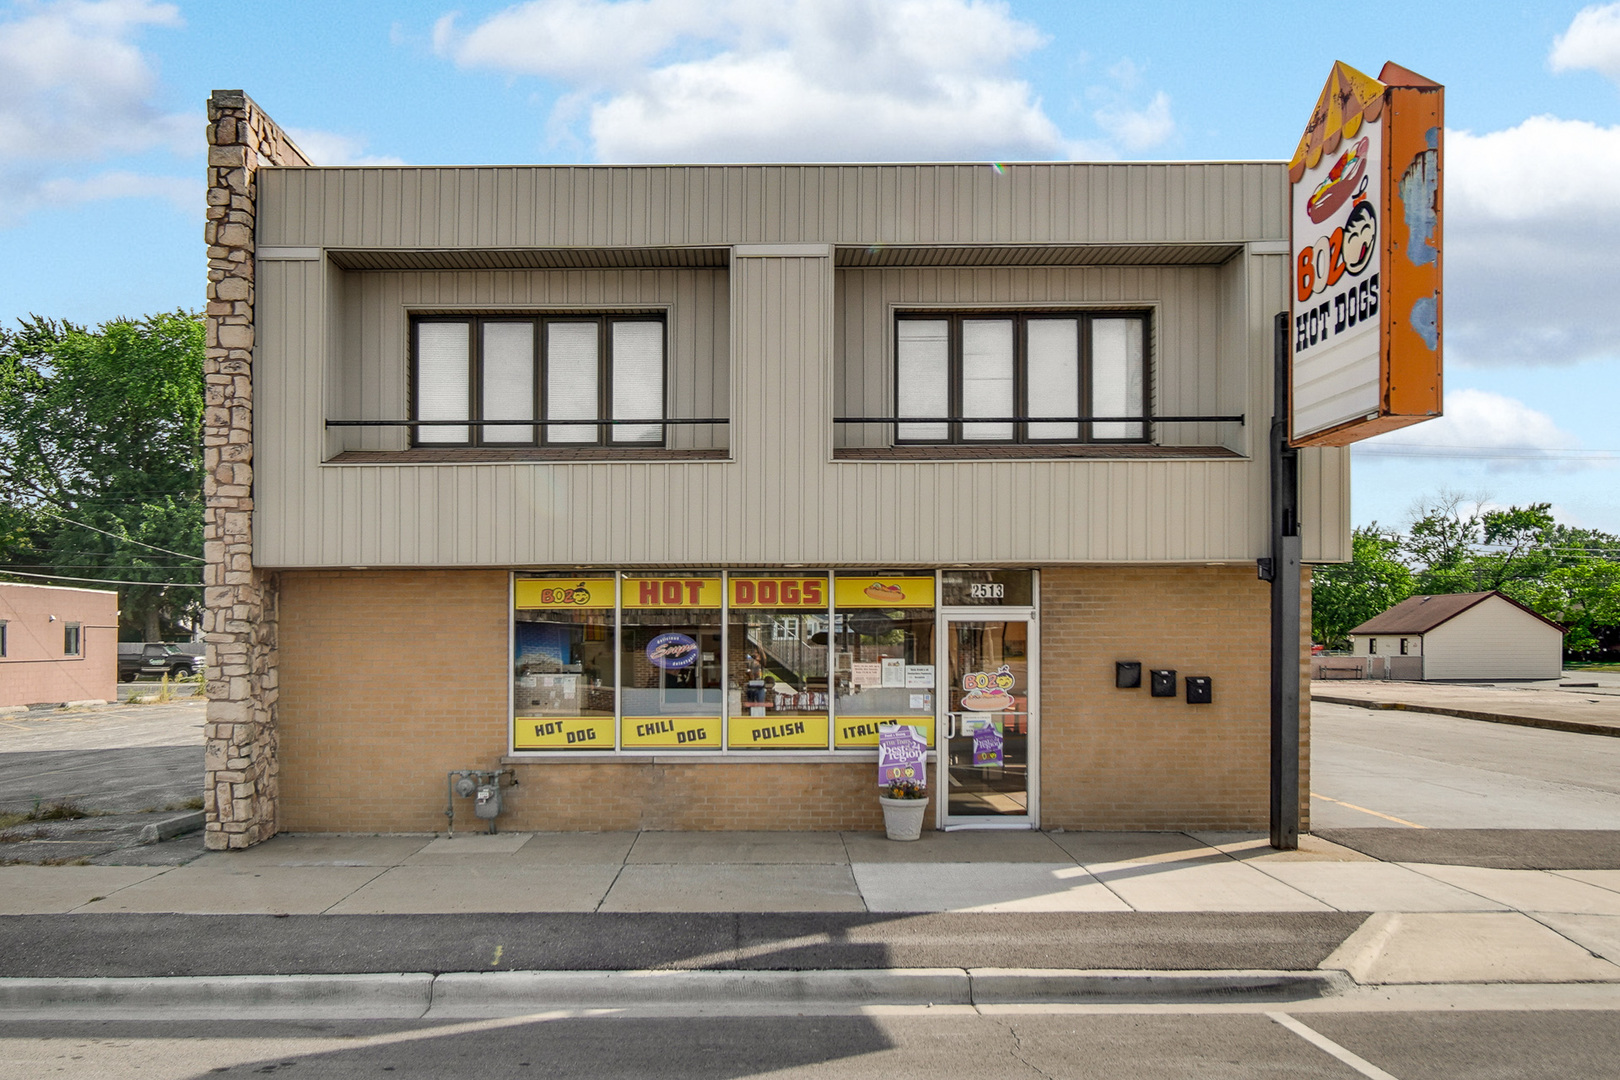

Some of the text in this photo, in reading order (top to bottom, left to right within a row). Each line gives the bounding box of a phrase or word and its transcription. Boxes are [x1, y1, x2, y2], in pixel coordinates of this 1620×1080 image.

[1295, 272, 1380, 353] HOT DOGS
[639, 580, 823, 605] HOT DOGS
[971, 584, 1004, 598] 2513
[534, 721, 563, 737] HOT
[566, 727, 597, 744] DOG
[636, 719, 675, 737] CHILI
[676, 727, 707, 744] DOG
[751, 721, 805, 742] POLISH
[889, 749, 922, 762] region
